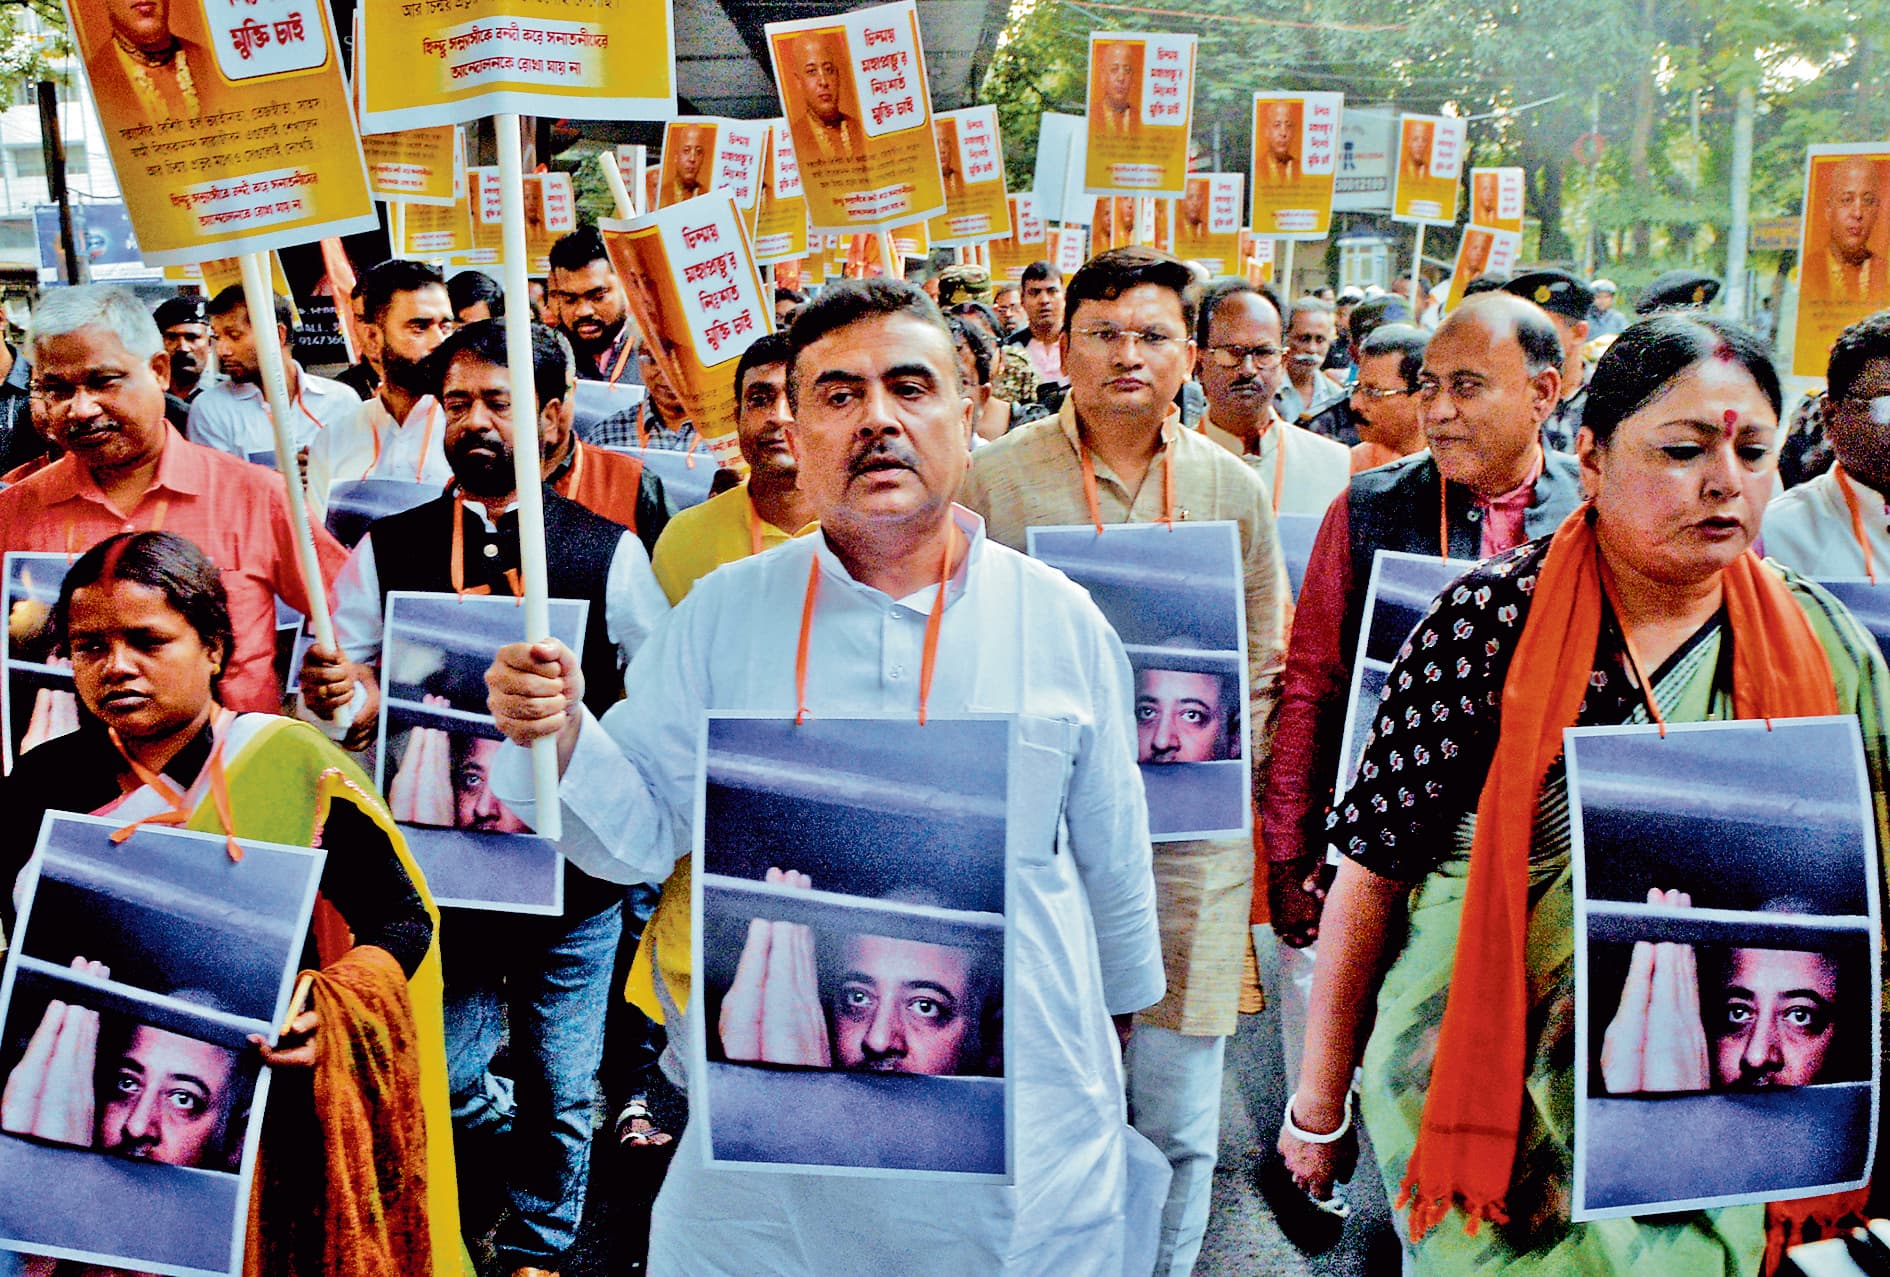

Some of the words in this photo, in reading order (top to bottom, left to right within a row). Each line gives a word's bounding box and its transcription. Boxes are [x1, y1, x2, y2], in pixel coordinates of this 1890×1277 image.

[229, 18, 270, 60] মুক্তি
[272, 11, 305, 45] চাই
[422, 37, 447, 58] হিন্দু
[522, 28, 543, 45] করে
[546, 27, 608, 48] সনাতনীদের
[864, 27, 896, 47] চিন্ময়
[450, 56, 514, 79] আন্দোলনকে
[517, 57, 544, 73] রোখা
[546, 60, 566, 75] যায়
[568, 61, 582, 75] না
[861, 51, 909, 72] মহাপ্রভু'র
[870, 73, 906, 96] নিঃশর্ত
[871, 101, 894, 125] মুক্তি
[896, 96, 915, 116] চাই
[682, 223, 719, 249] চিন্ময়
[684, 251, 737, 283] মহাপ্রভু'র
[699, 277, 740, 312] নিঃশর্ত
[705, 319, 731, 351] মুক্তি
[732, 309, 753, 335] চাই
